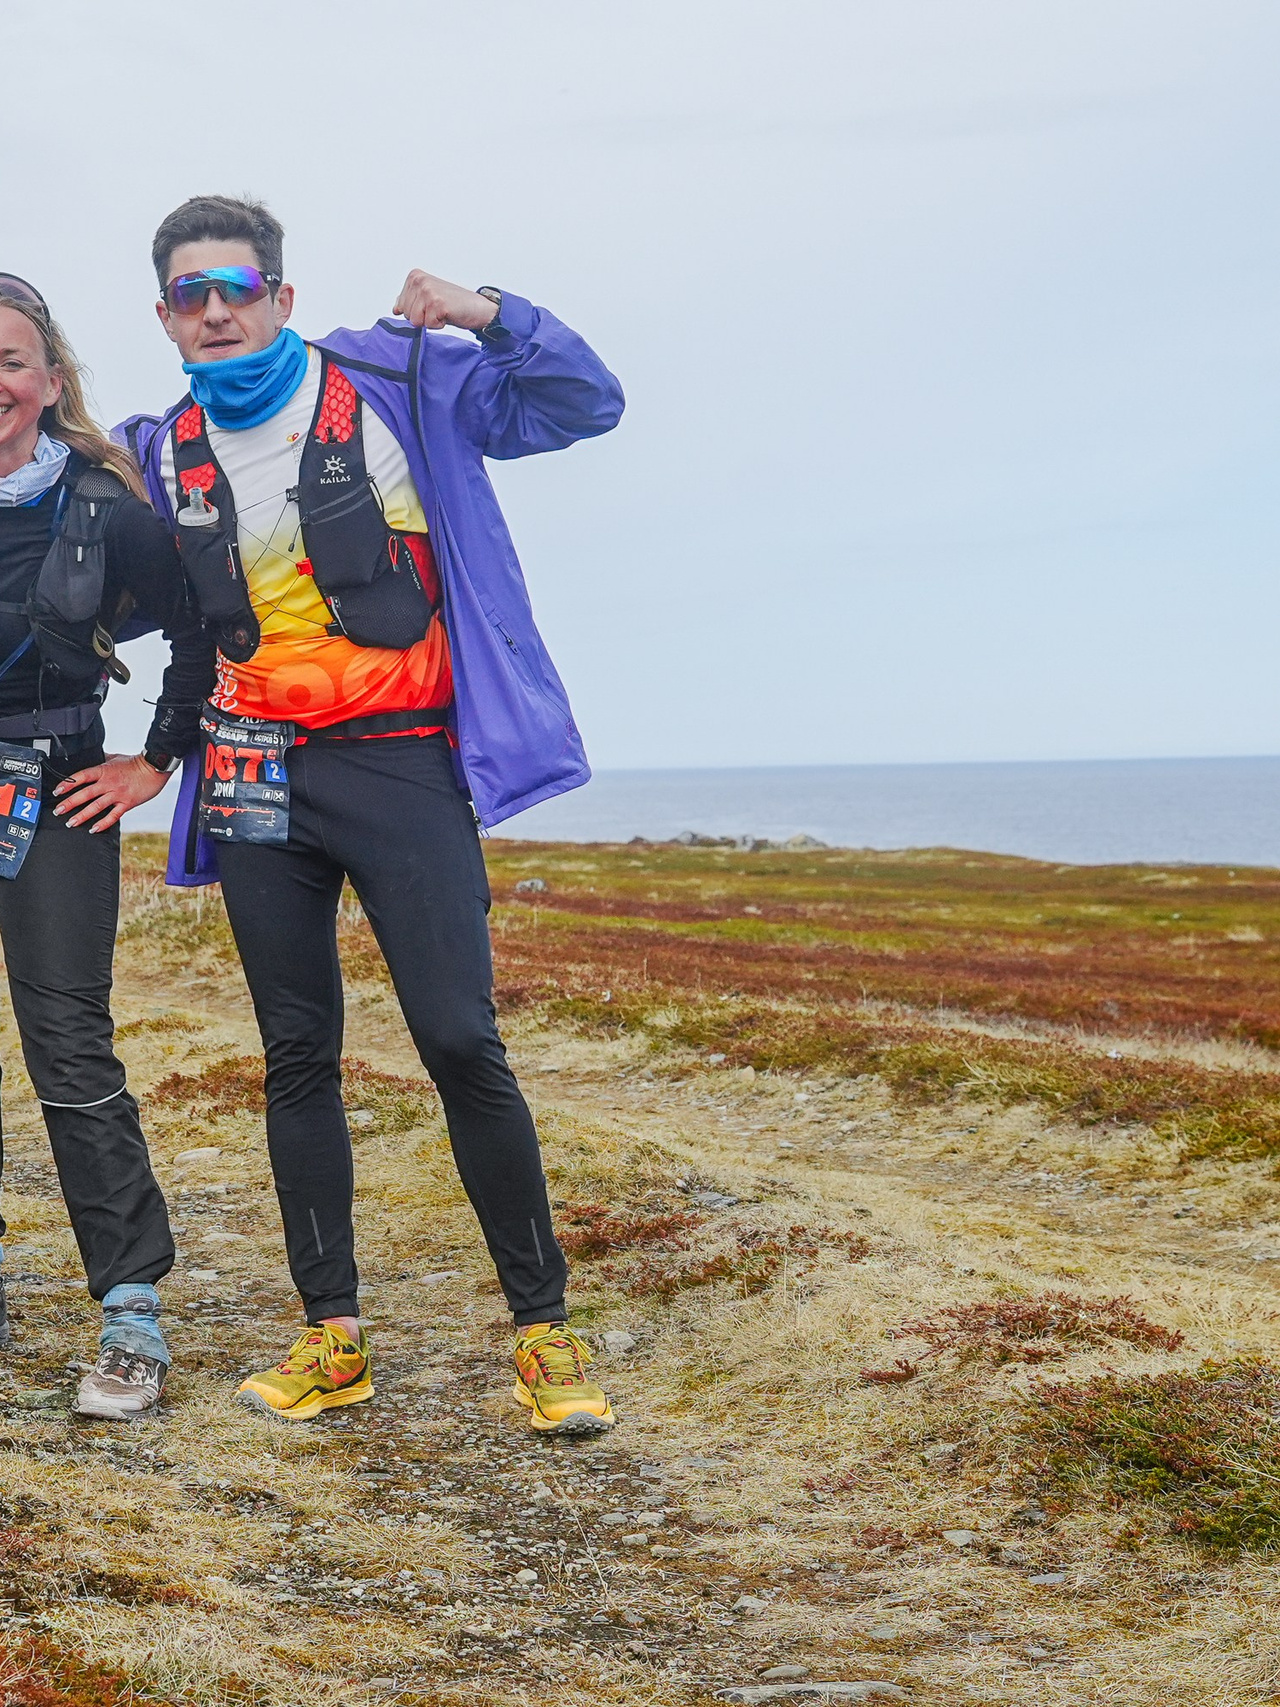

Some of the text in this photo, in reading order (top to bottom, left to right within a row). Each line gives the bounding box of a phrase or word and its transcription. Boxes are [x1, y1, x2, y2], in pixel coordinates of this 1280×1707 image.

[320, 475, 351, 485] KAILAS
[25, 763, 39, 775] 50
[205, 742, 263, 783] 067
[270, 763, 280, 779] 2
[20, 801, 31, 818] 2
